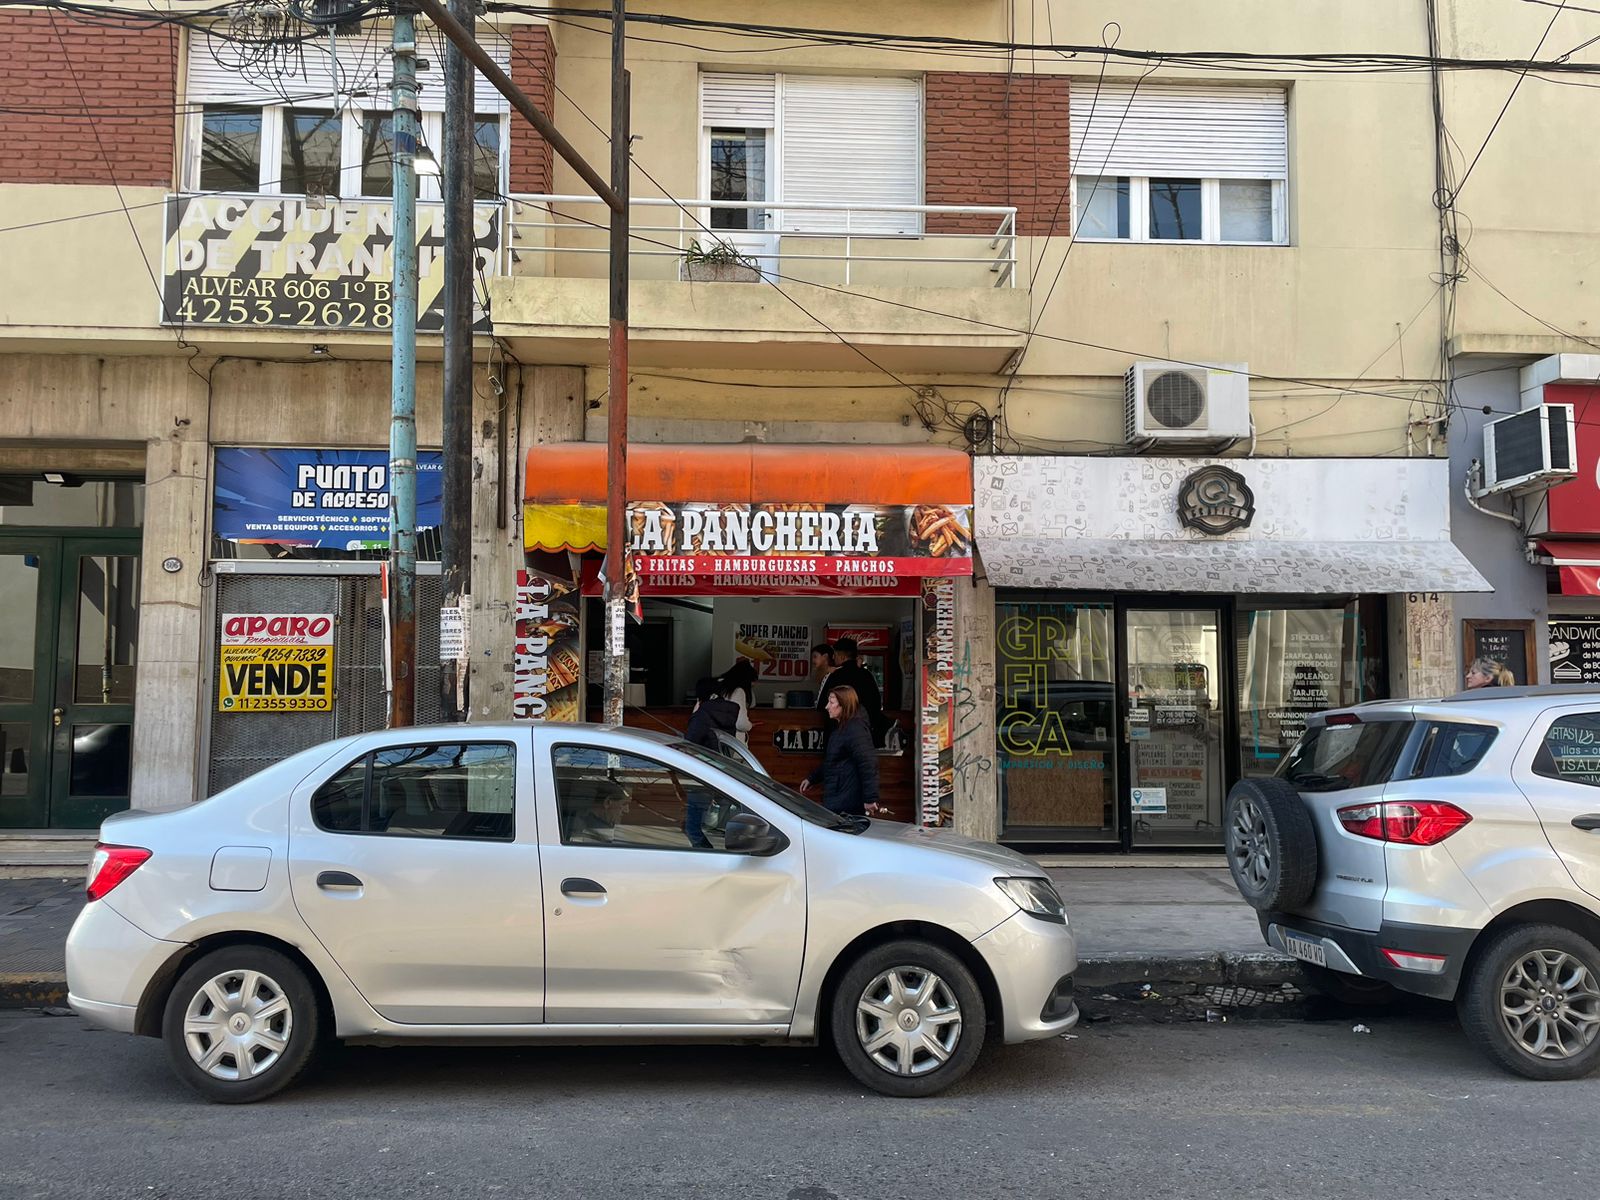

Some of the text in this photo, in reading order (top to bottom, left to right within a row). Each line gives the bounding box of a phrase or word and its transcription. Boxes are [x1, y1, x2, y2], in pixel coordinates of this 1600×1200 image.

[177, 239, 237, 272] DE
[183, 277, 277, 299] ALVEAR
[284, 281, 330, 300] 606
[175, 296, 392, 327] 4253-2628
[298, 464, 387, 492] PUNTO
[292, 491, 389, 509] DE ACCESO
[246, 523, 274, 531] VENTA
[328, 524, 378, 532] ACCESORIOS
[278, 515, 315, 523] SERVICIO
[316, 514, 350, 523] TÉCNICO
[626, 510, 664, 550] LA
[649, 559, 695, 571] FRITAS
[714, 560, 816, 572] HAMBURGUESAS
[836, 561, 895, 573] PANCHOS
[516, 585, 549, 622] LA
[1409, 592, 1439, 603] 614
[740, 624, 809, 639] SUPER PANCHO
[1290, 633, 1325, 641] STICKERS
[226, 663, 327, 696] VENDE
[1003, 664, 1048, 709] FI
[1292, 688, 1329, 697] TARJETAS
[782, 729, 804, 750] LA
[998, 711, 1073, 756] CA
